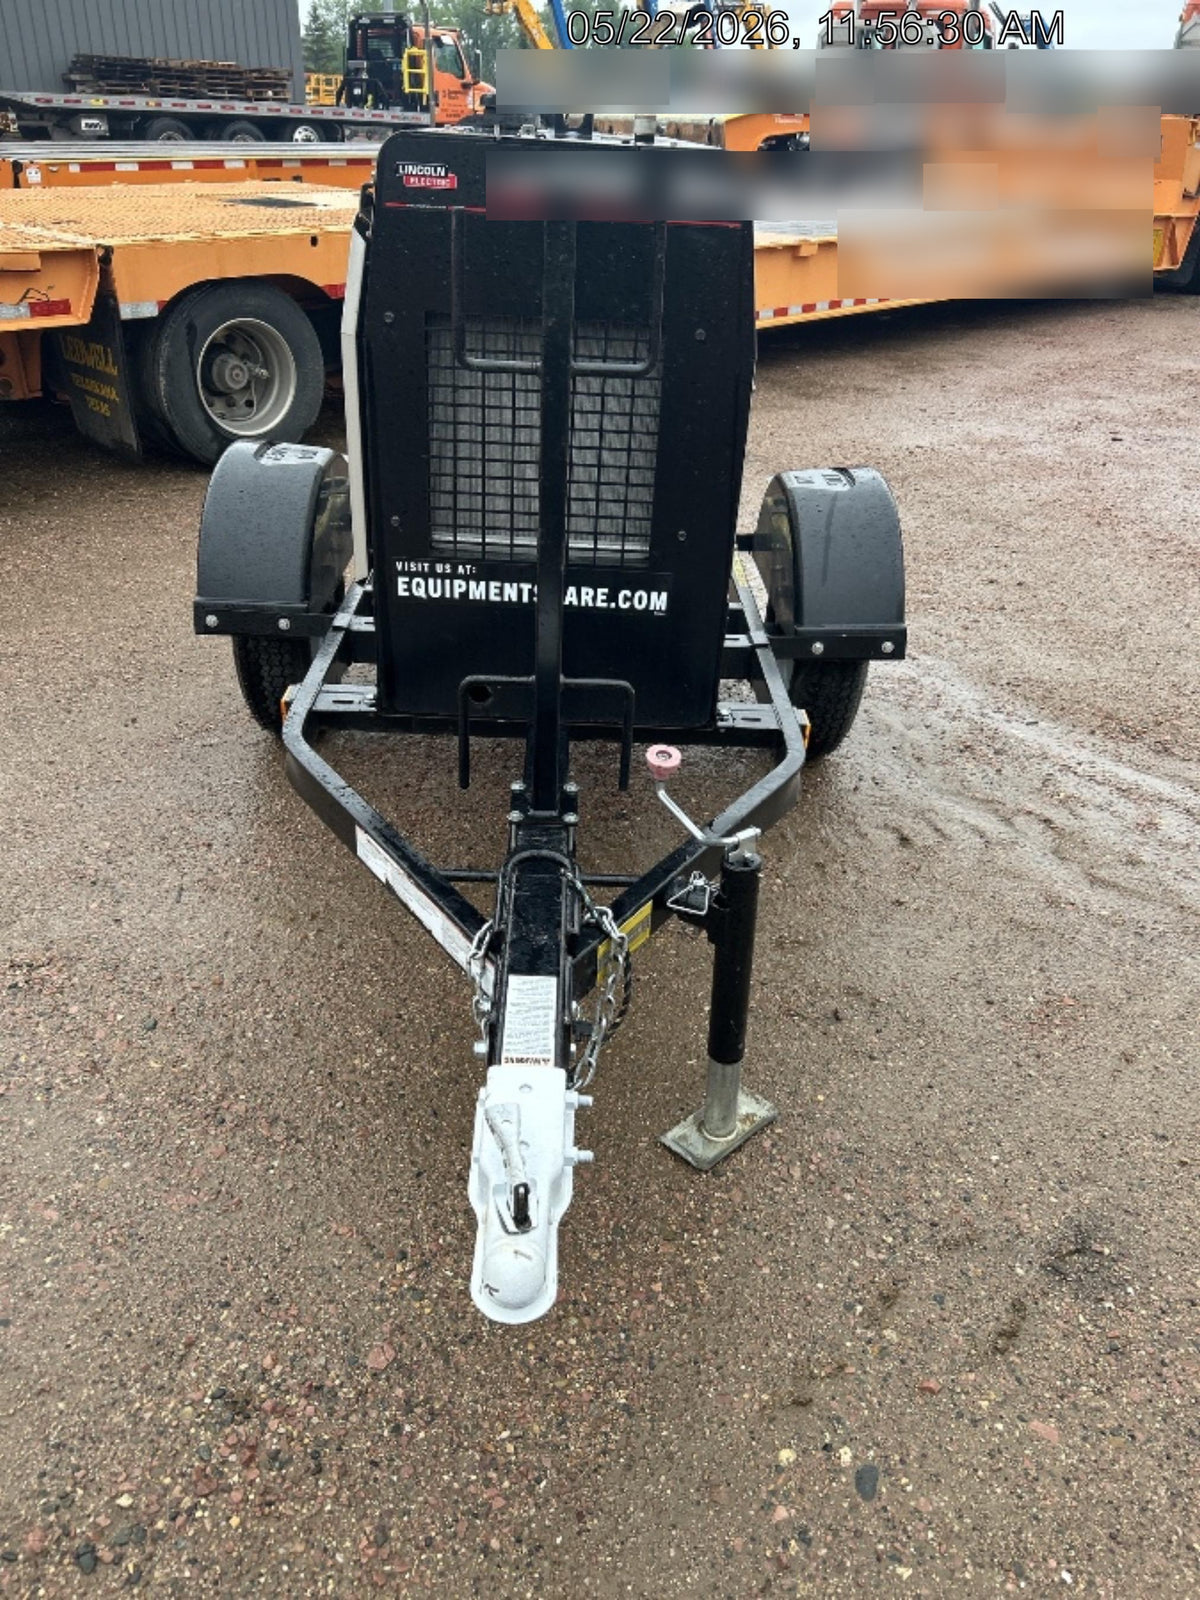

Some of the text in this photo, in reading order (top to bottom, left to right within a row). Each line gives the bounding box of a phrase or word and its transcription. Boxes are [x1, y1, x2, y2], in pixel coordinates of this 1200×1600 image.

[398, 164, 446, 177] LINCOLN
[396, 561, 477, 576] VISIT US AT:
[396, 576, 668, 611] EQUIPMENTARE.COM
